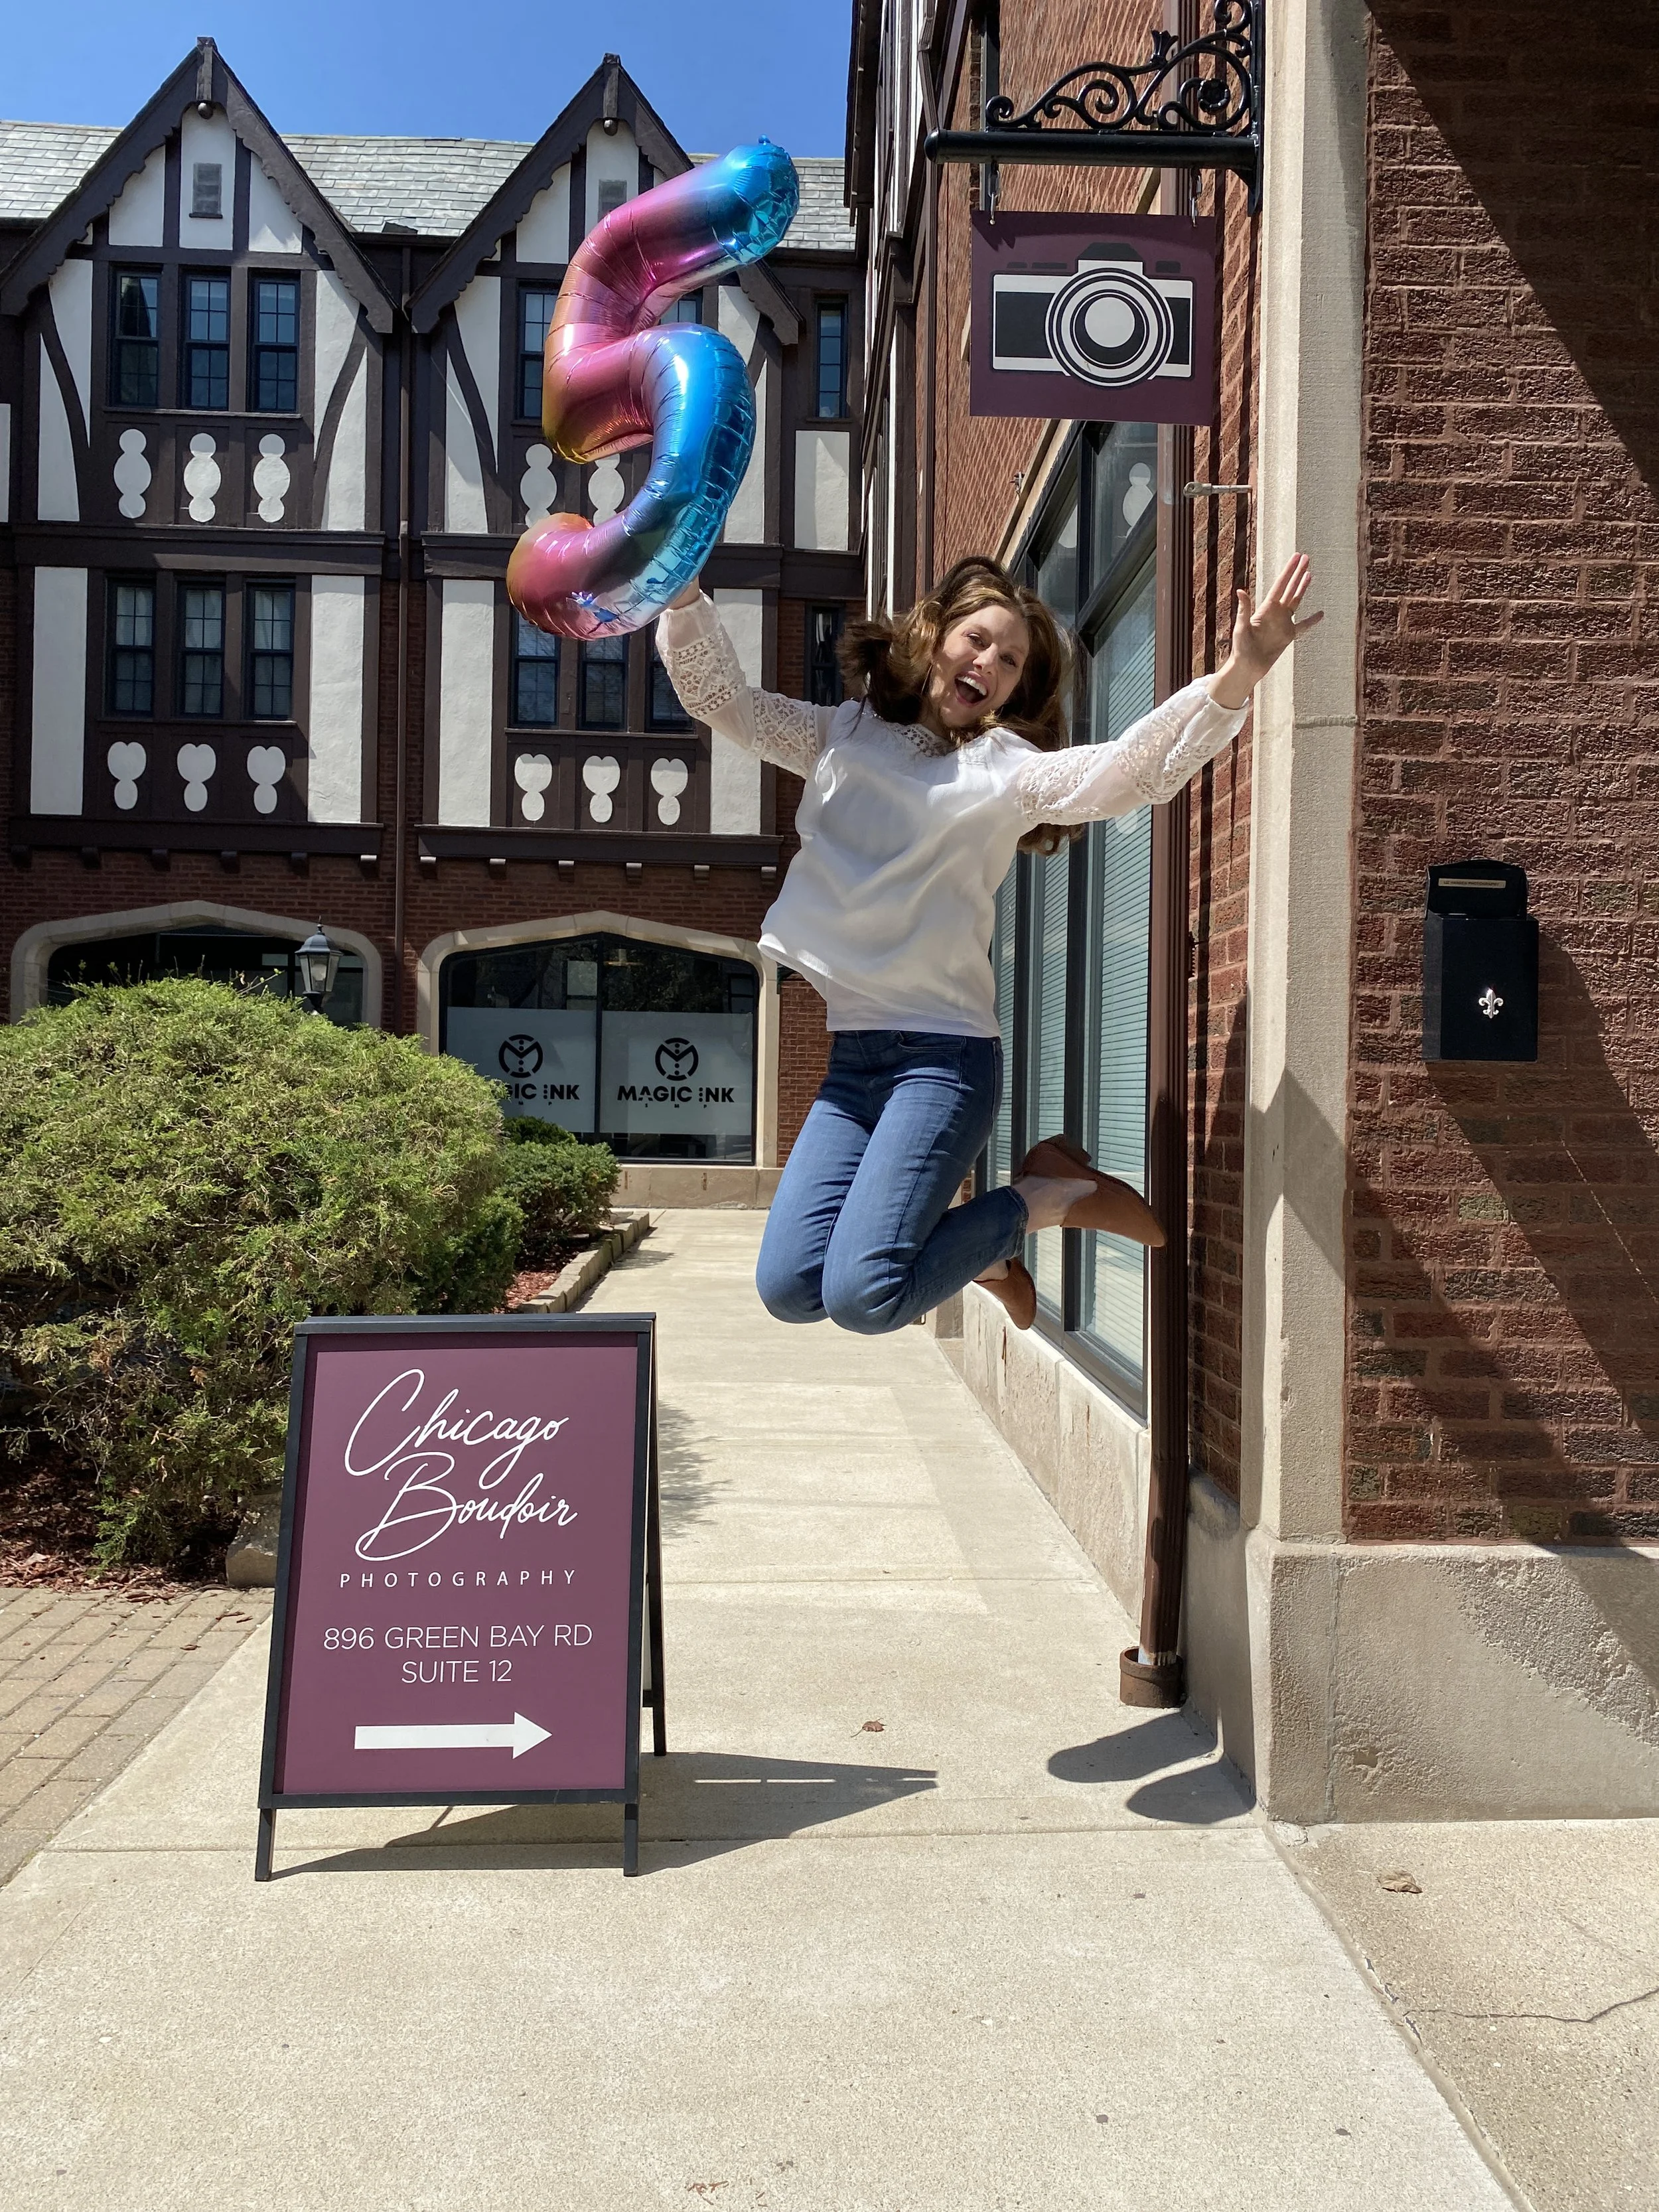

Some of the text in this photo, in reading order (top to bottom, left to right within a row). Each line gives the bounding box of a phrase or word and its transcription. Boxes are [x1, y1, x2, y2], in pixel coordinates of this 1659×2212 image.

[616, 1085, 693, 1102] MAGIC
[344, 1368, 569, 1490] Chicago
[355, 1451, 578, 1562] Boudoir
[339, 1570, 575, 1588] PHOTOGRAPHY
[323, 1624, 593, 1650] 896 GREEN BAY RD
[401, 1659, 513, 1684] SUITE 12
